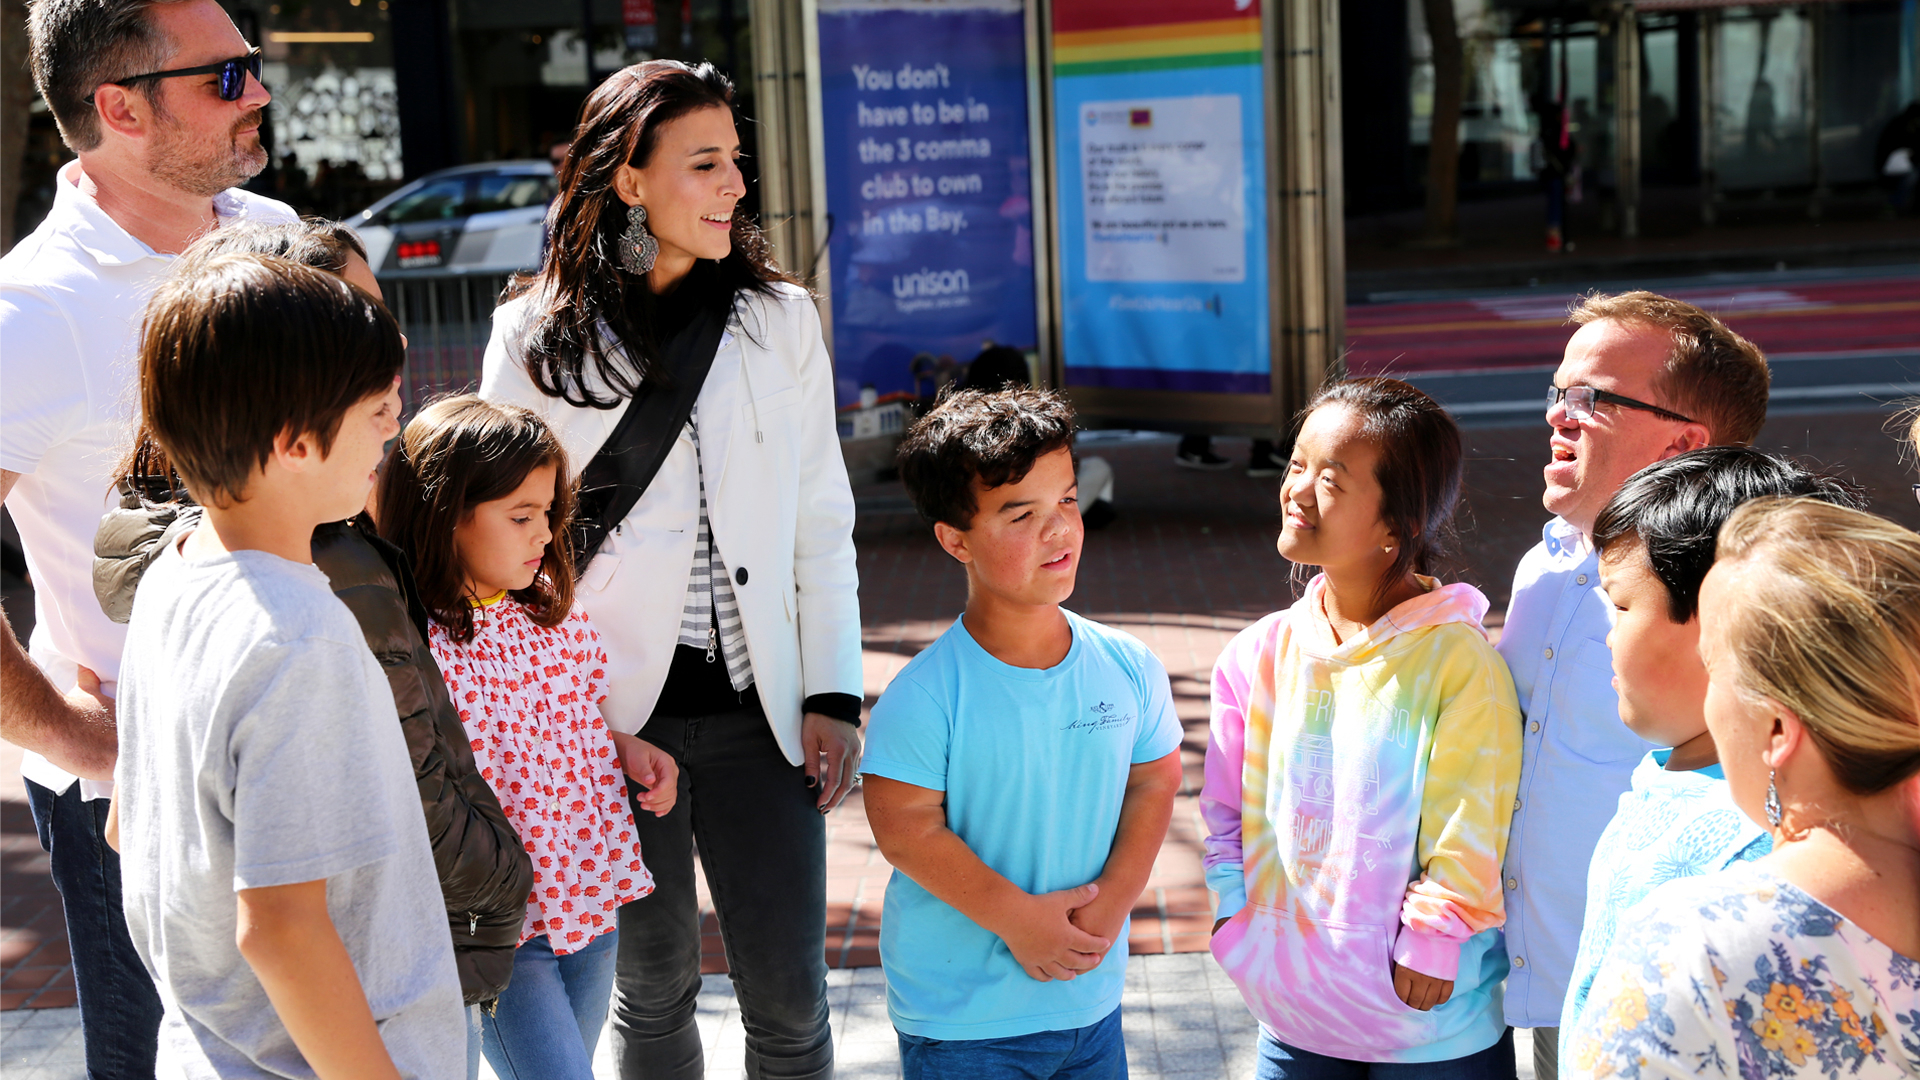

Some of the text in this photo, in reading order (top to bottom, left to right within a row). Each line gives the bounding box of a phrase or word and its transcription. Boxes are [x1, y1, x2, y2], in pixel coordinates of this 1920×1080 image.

[852, 62, 950, 90] You don't
[858, 97, 989, 127] have to be in
[858, 137, 991, 163] the 3 comma
[861, 173, 982, 200] club to own
[863, 206, 968, 236] in the Bay.
[893, 267, 969, 298] unison
[1060, 713, 1136, 734] King Family
